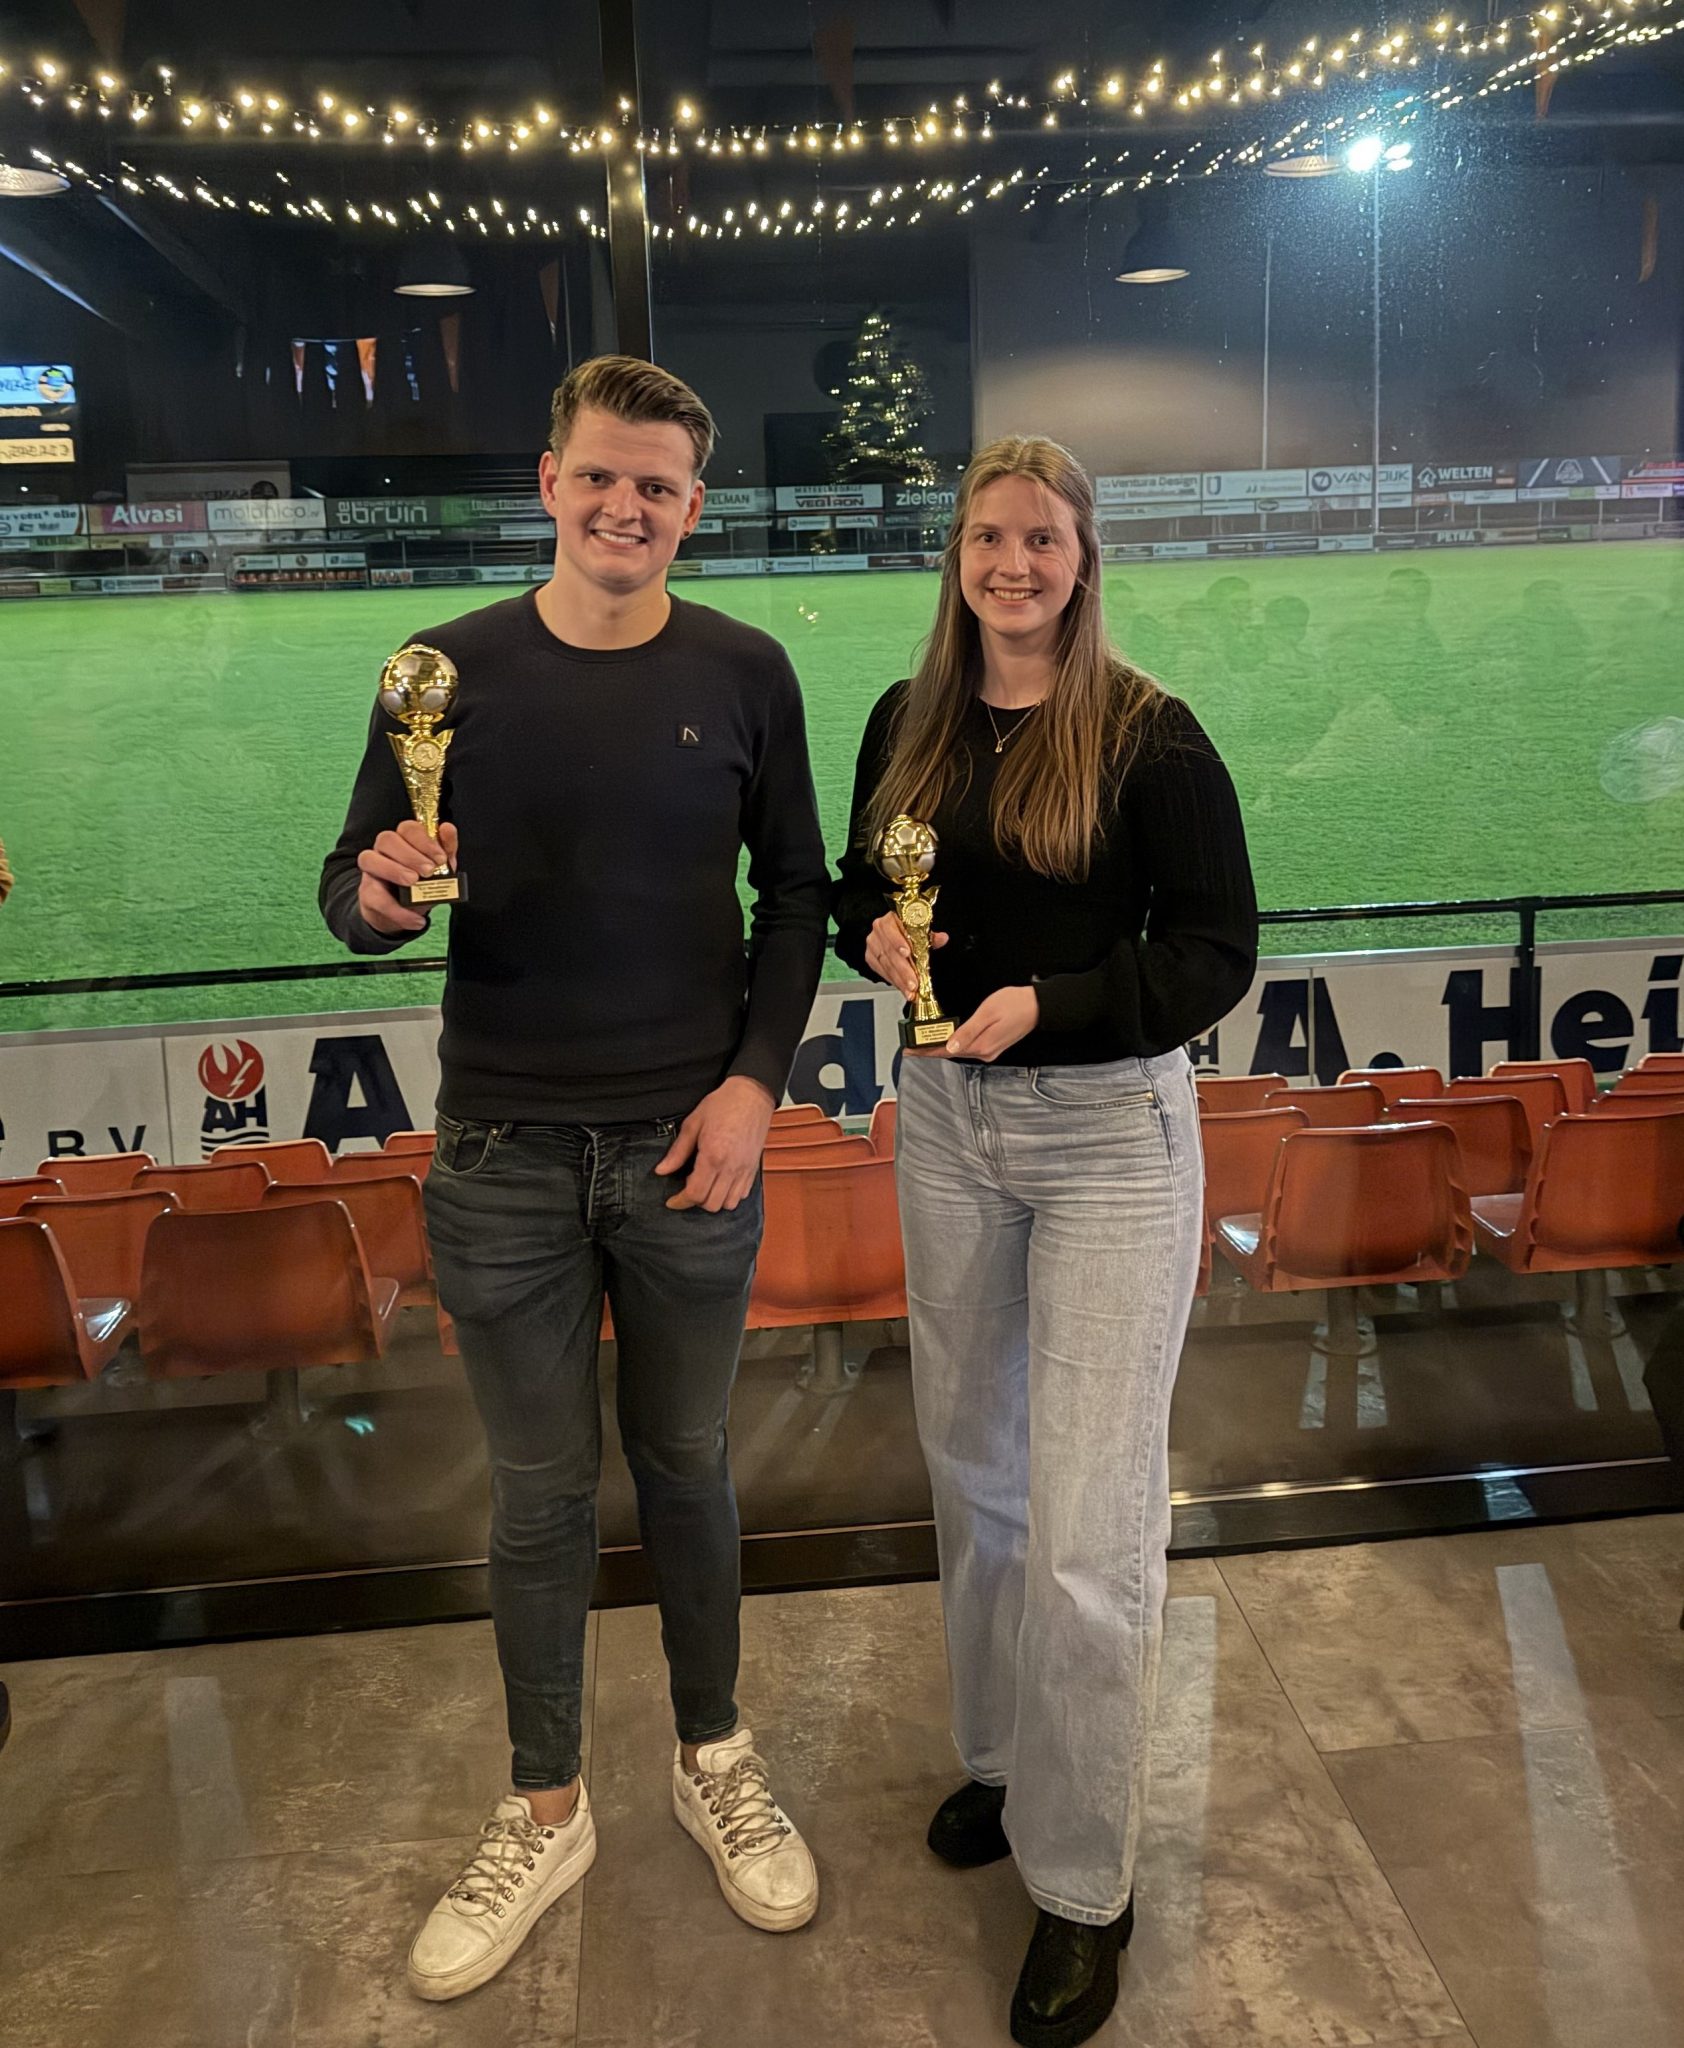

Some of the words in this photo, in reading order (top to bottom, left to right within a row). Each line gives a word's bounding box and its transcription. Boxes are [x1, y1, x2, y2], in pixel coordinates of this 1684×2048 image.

[1333, 471, 1372, 483] VAN
[1438, 466, 1493, 480] WELTEN
[111, 503, 184, 524] Alvasi
[351, 501, 428, 524] bruin
